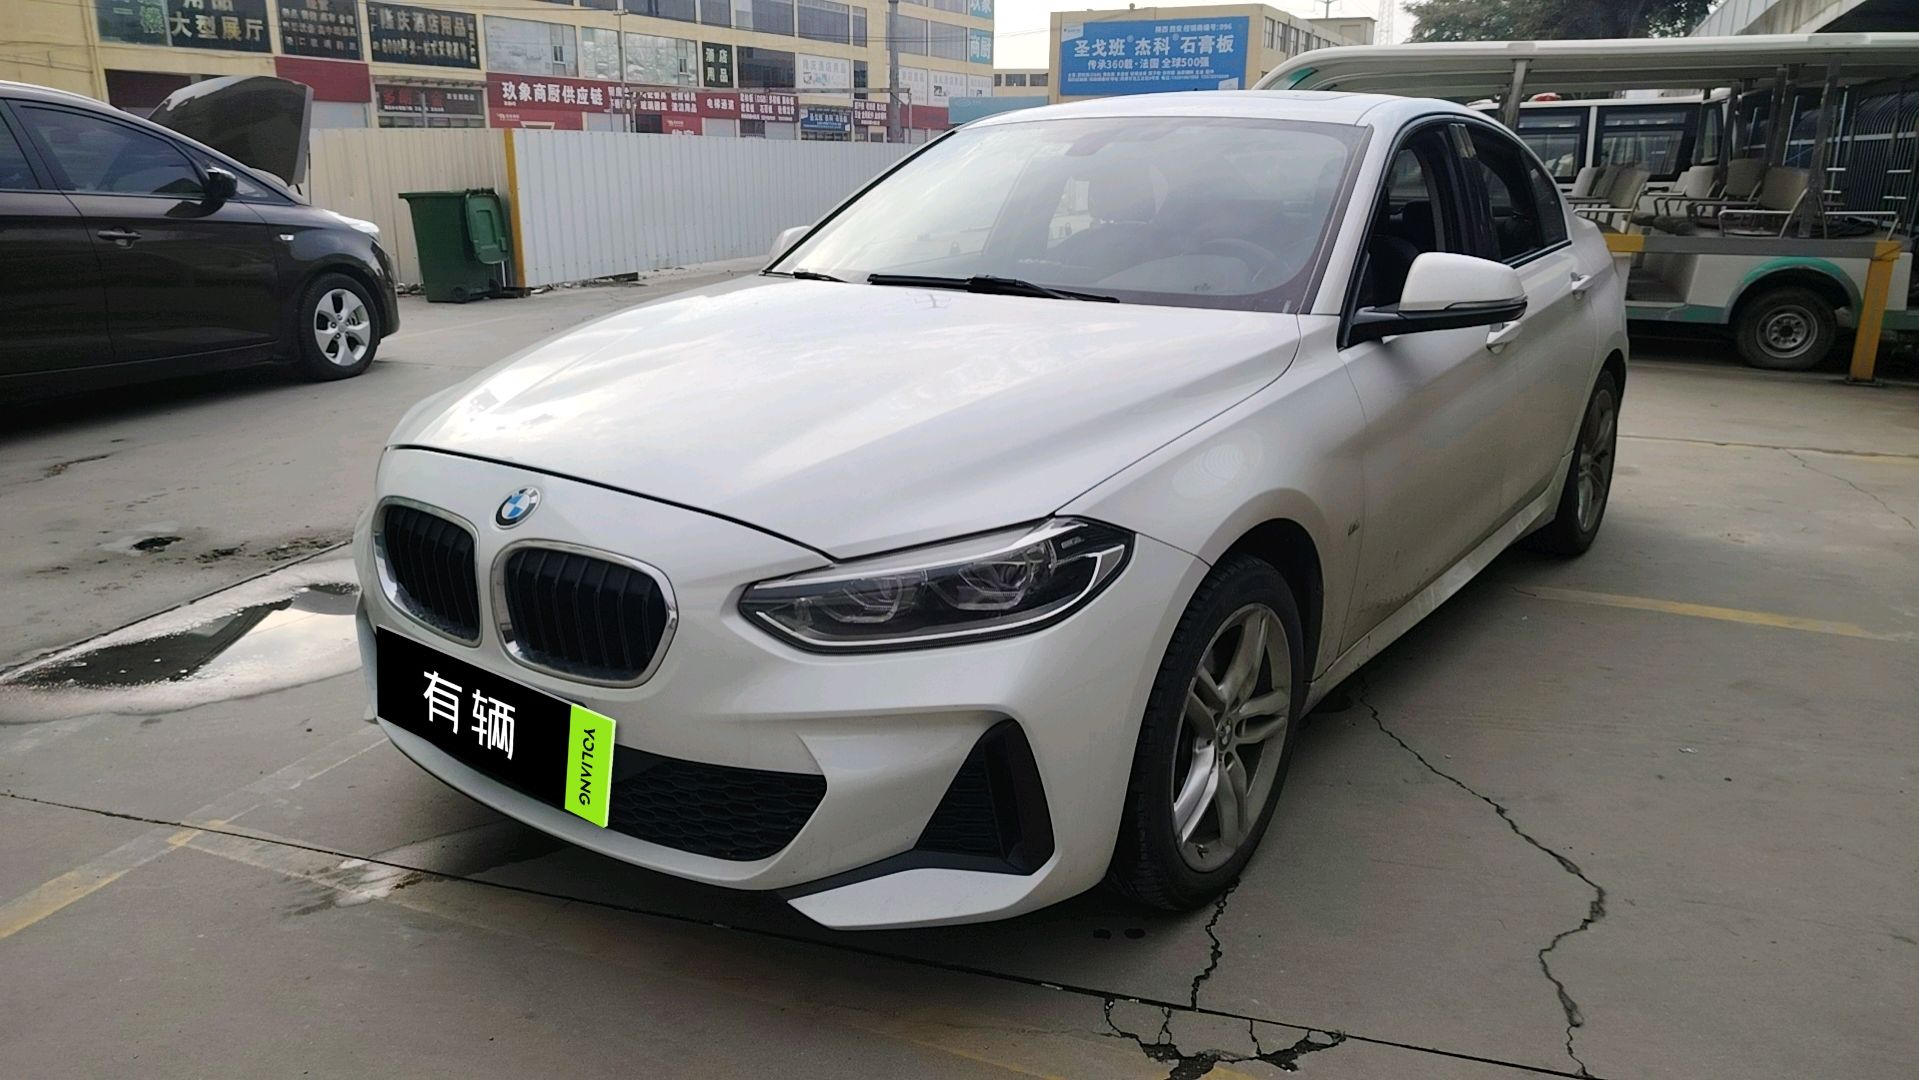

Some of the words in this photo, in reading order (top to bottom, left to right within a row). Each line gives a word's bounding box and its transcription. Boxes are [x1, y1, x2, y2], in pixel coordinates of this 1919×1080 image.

[169, 11, 264, 42] 大型展厅
[1074, 39, 1126, 57] 圣戈班
[1135, 37, 1171, 56] 杰科
[1180, 33, 1235, 54] 石膏板
[705, 47, 728, 64] 酒店
[1161, 55, 1210, 68] 全球500强
[706, 66, 729, 83] 用品
[501, 80, 604, 106] 玖象商厨供应链
